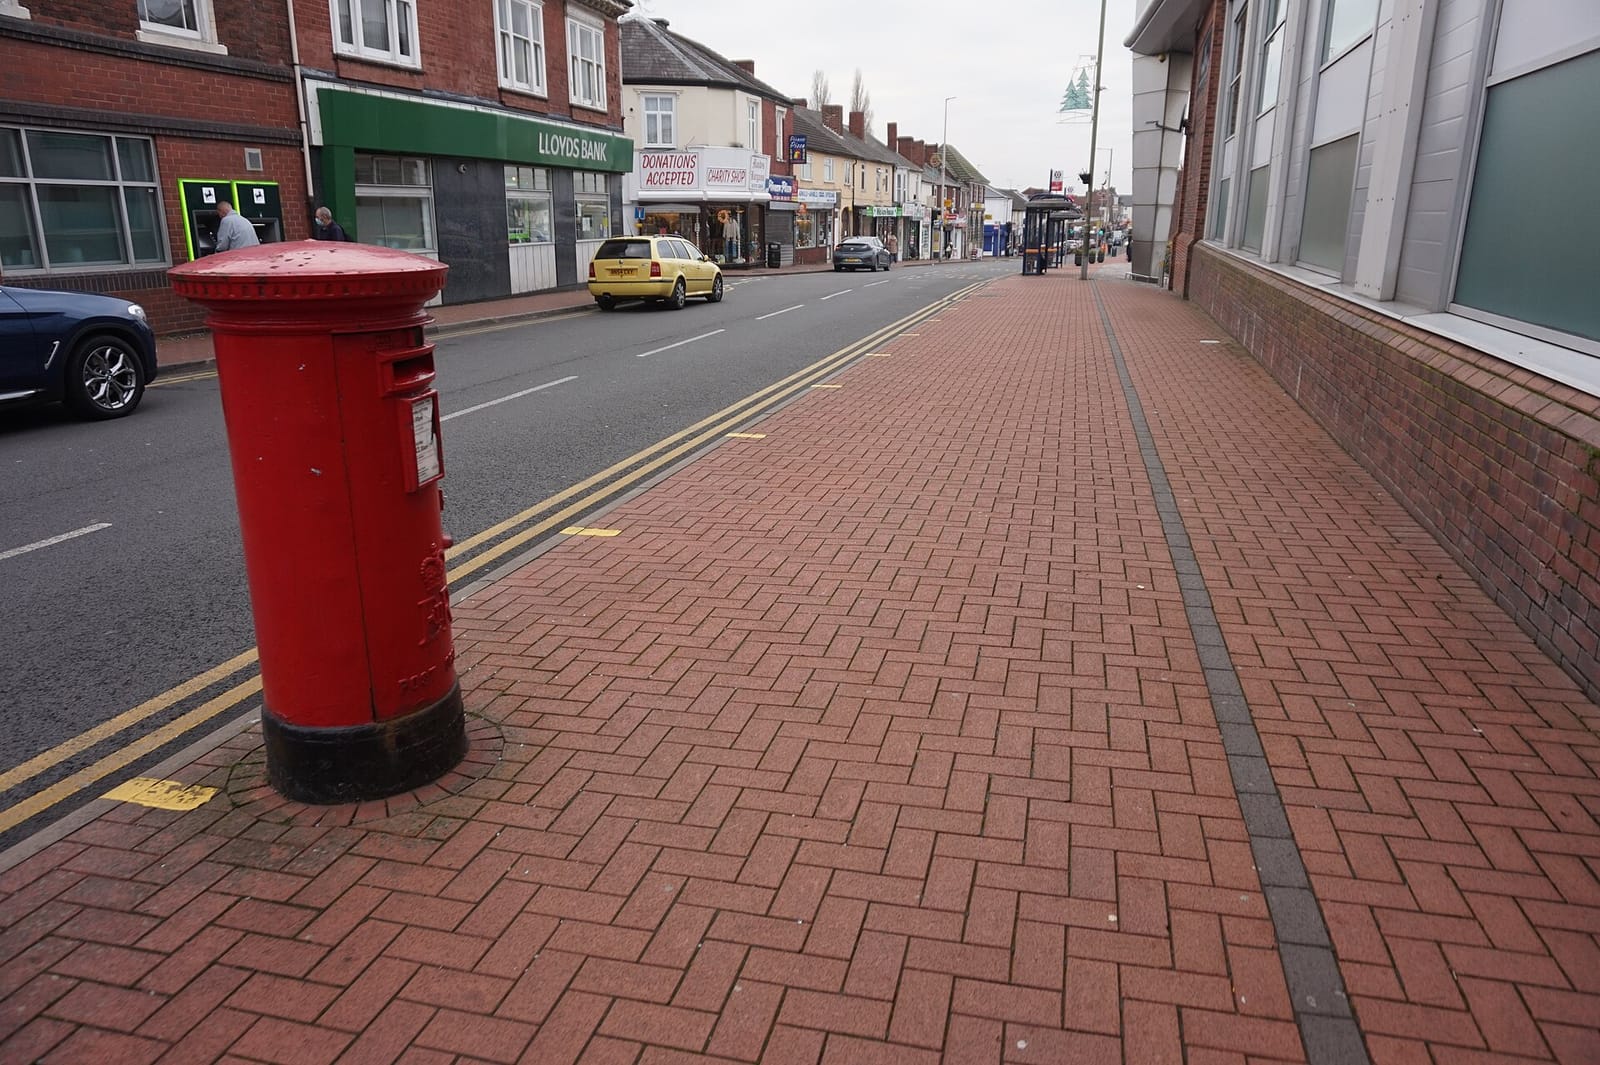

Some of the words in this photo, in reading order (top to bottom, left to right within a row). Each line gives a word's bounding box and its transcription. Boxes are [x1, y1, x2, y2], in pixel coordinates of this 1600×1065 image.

[539, 132, 580, 159] LLOYDS
[581, 139, 607, 162] BANK
[642, 154, 697, 169] DONATIONS
[646, 171, 695, 186] ACCEPTED
[708, 169, 731, 183] CHARITY
[731, 170, 746, 184] SHOP
